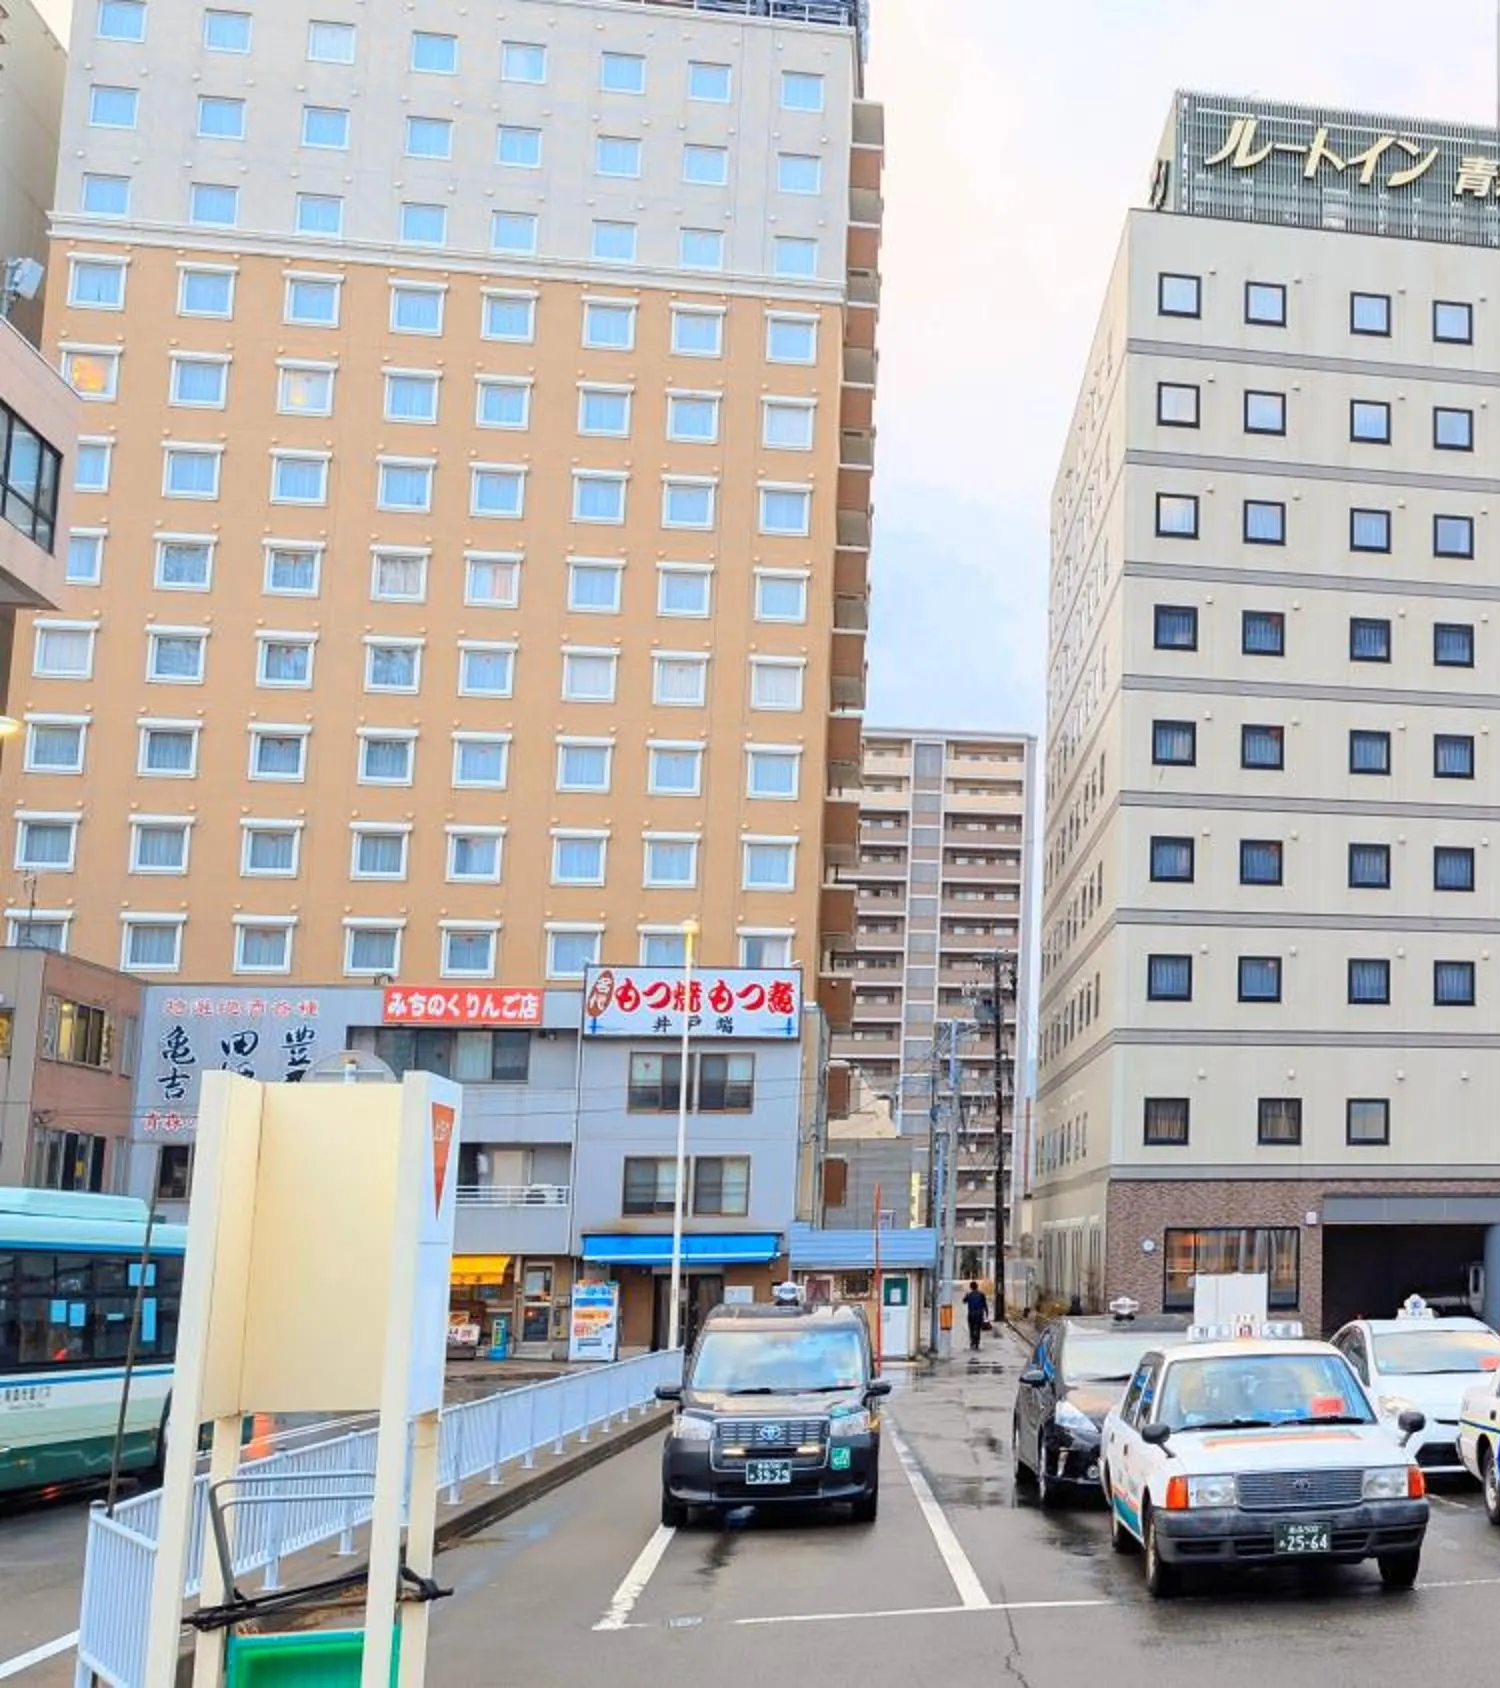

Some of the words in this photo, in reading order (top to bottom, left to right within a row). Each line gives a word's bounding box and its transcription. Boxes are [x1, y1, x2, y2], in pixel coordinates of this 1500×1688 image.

[1204, 119, 1439, 187] ルートイン
[387, 992, 539, 1019] みちのくりんご店
